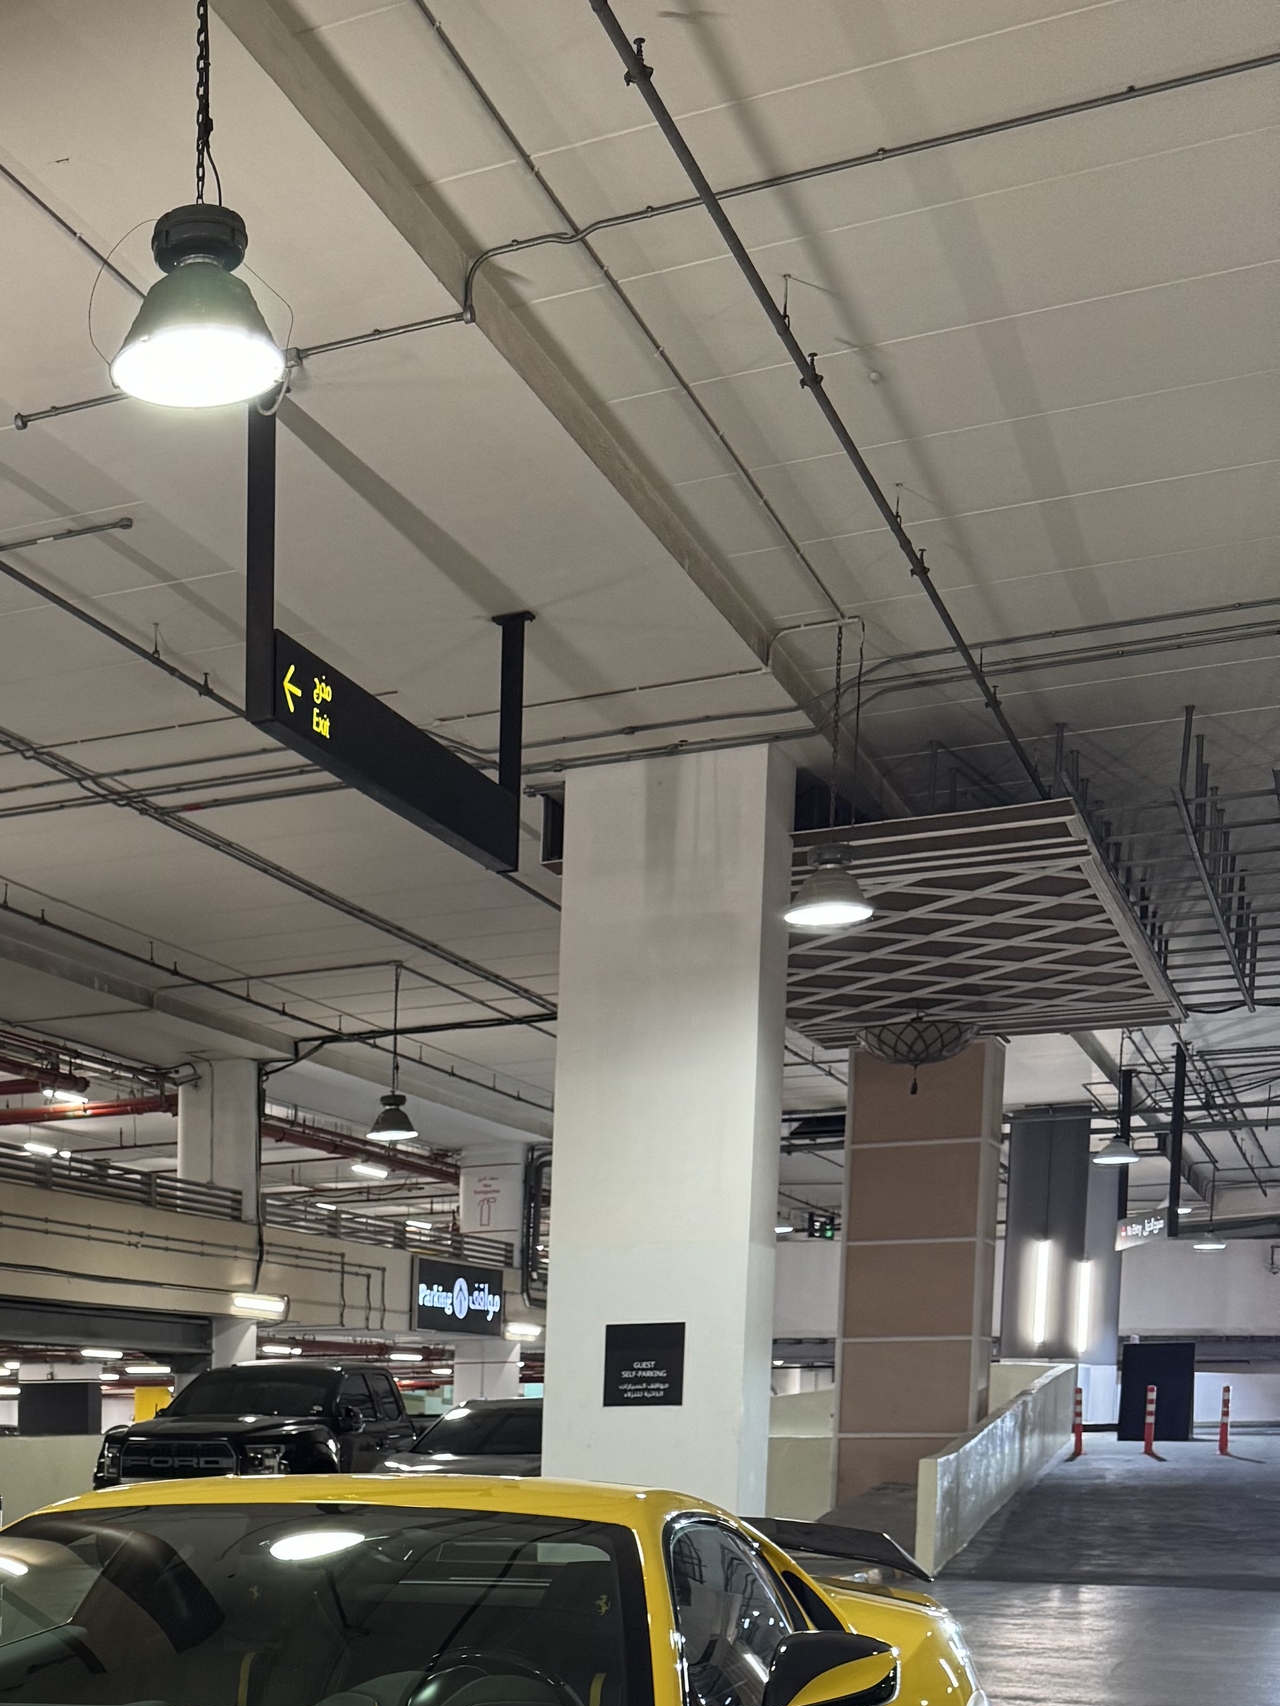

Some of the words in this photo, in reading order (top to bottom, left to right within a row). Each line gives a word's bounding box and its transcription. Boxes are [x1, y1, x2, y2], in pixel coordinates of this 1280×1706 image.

[312, 707, 330, 739] Exit
[418, 1283, 453, 1316] Parking
[468, 1283, 500, 1322] مواقف
[621, 1370, 667, 1378] SELF-PARKING
[633, 1361, 656, 1369] GUEST
[122, 1456, 234, 1468] FORD
